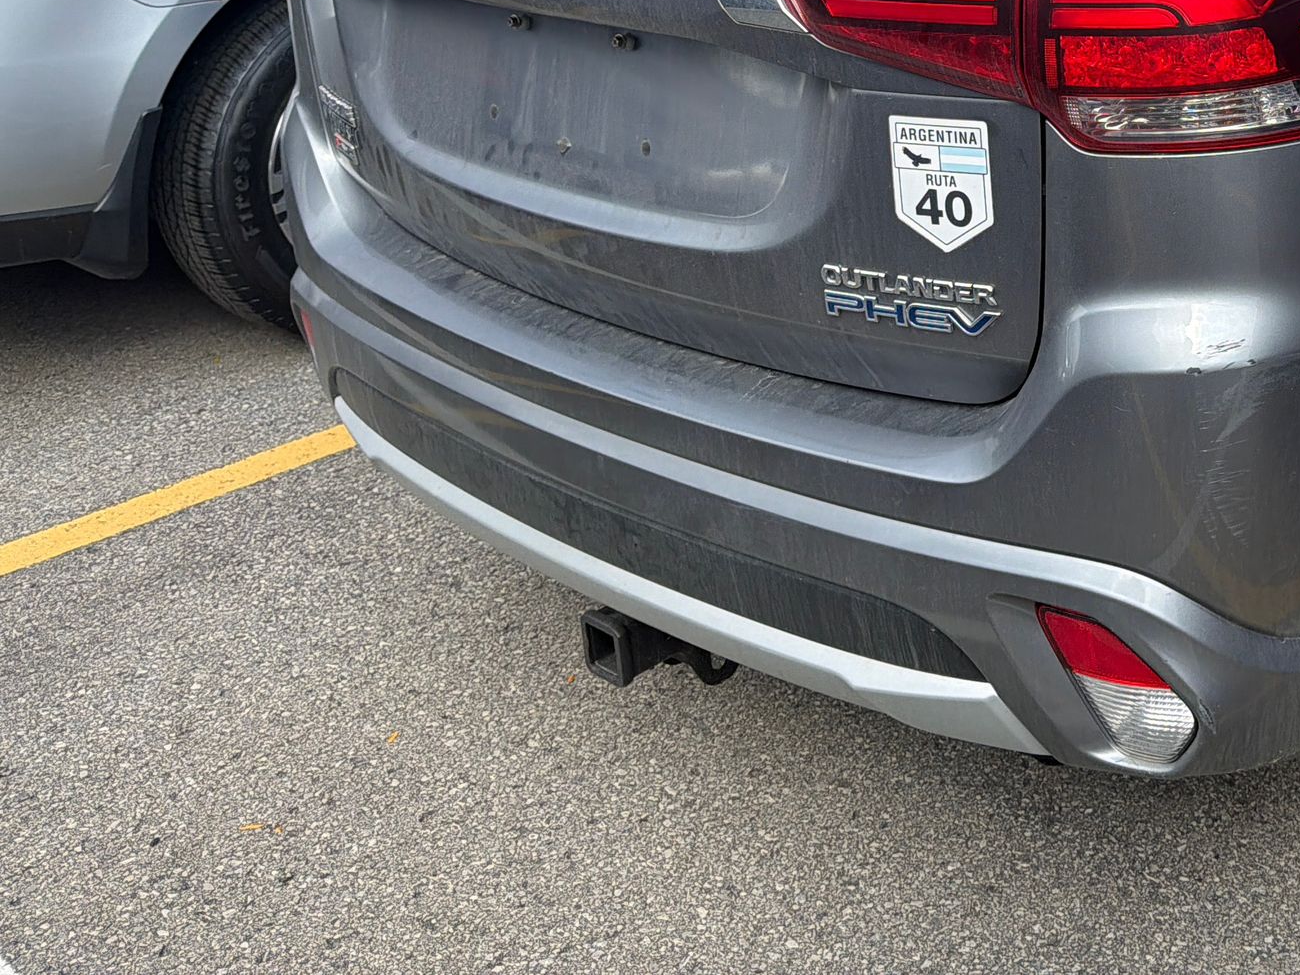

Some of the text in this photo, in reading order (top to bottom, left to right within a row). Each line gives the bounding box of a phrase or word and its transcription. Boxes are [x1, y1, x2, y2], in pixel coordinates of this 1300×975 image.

[900, 127, 977, 145] ARGENTINA
[926, 174, 957, 187] RUTA
[915, 189, 973, 227] 40
[820, 264, 998, 306] OUTLANDER
[824, 289, 1003, 336] PHEV
